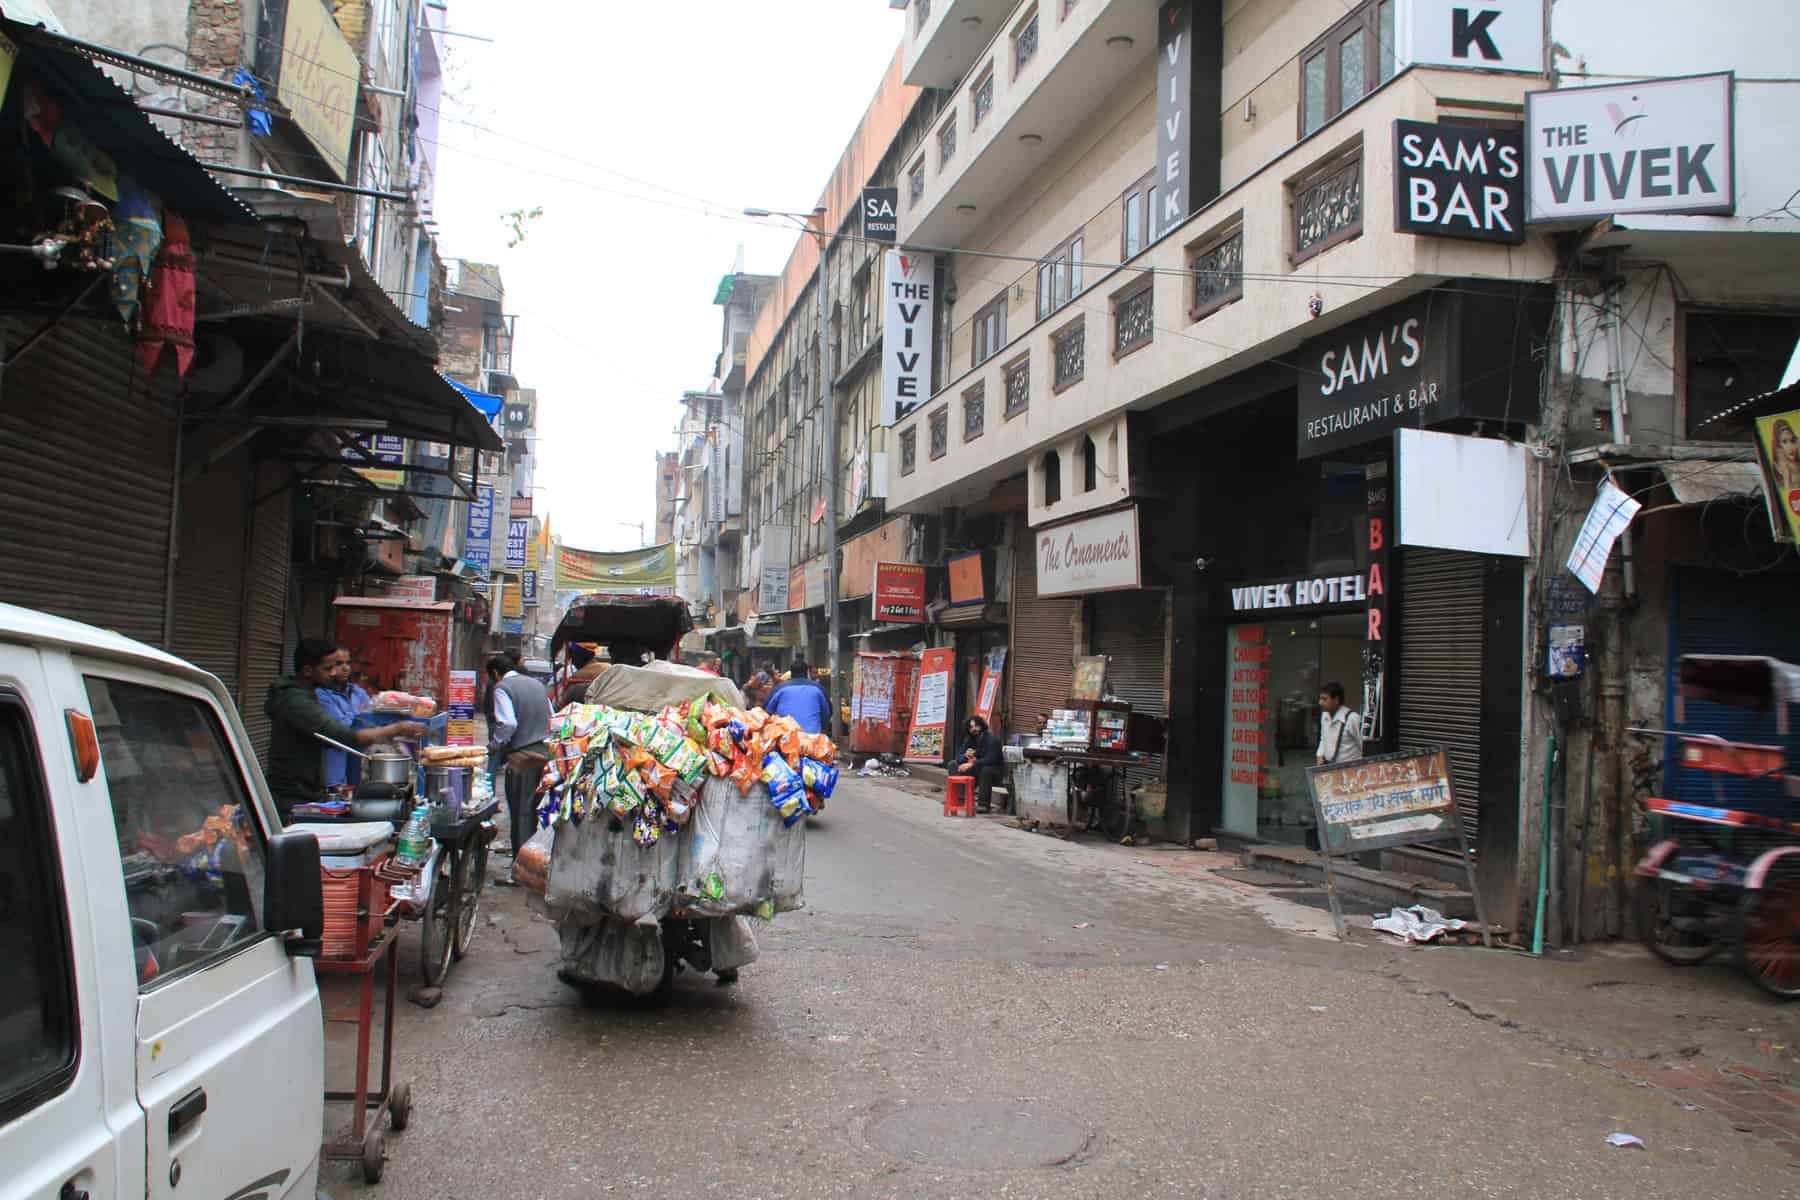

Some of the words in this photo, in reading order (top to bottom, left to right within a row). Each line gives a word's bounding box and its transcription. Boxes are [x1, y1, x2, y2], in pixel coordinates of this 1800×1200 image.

[1165, 33, 1183, 221] VIVEK
[1542, 124, 1588, 147] THE
[1402, 133, 1520, 179] SAM'S
[1543, 143, 1718, 204] VIVEK
[867, 198, 897, 217] SA
[1409, 177, 1513, 232] BAR
[892, 282, 930, 300] THE
[1321, 318, 1420, 396] SAM'S
[1307, 398, 1389, 441] RESTAURANT
[1393, 394, 1404, 414] &
[1408, 383, 1439, 410] BAR
[510, 523, 526, 537] AY
[1041, 536, 1061, 573] The
[1065, 531, 1129, 568] Ornaments
[1232, 583, 1292, 611] VIVEK
[1296, 574, 1367, 605] HOTEL
[1367, 518, 1384, 640] BAR
